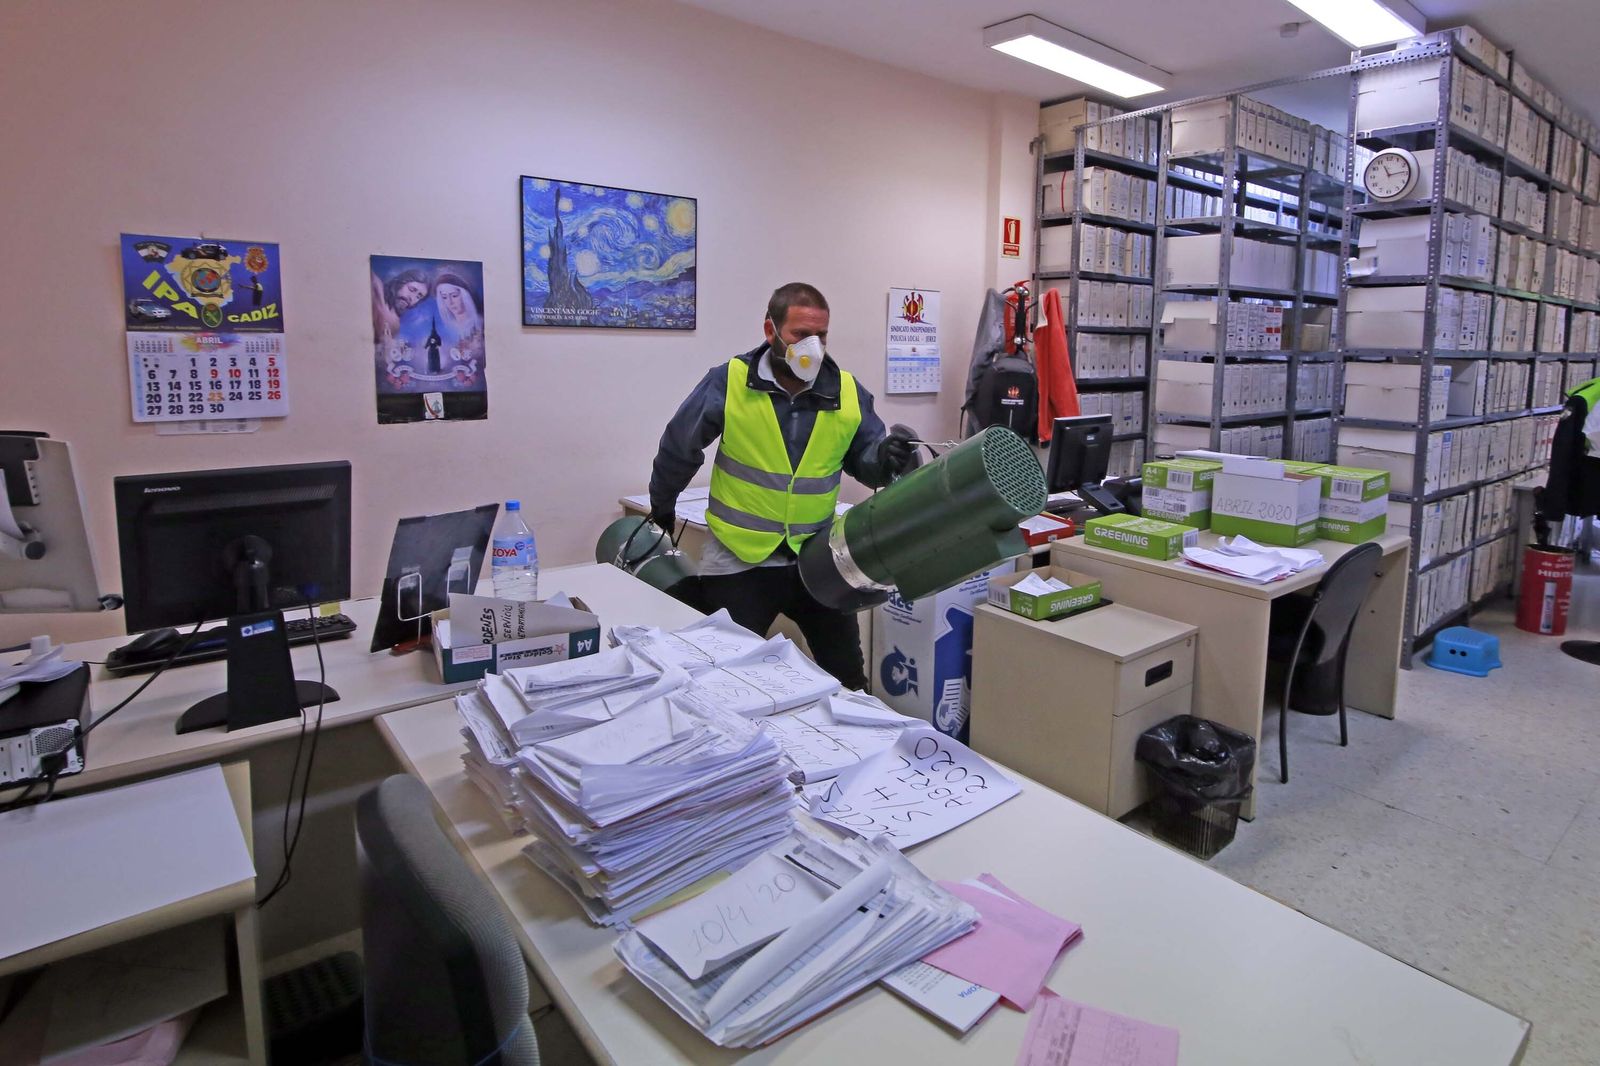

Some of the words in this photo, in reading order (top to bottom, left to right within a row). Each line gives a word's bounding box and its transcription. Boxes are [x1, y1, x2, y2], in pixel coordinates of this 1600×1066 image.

[142, 270, 198, 319] IPA
[227, 303, 278, 323] CADIZ
[196, 336, 224, 344] ABRIL
[190, 358, 196, 367] 1
[210, 358, 217, 366] 2
[230, 358, 237, 366] 3
[249, 358, 257, 366] 4
[268, 358, 275, 366] 5
[148, 371, 156, 380] 6
[169, 370, 177, 378] 7
[190, 370, 198, 378] 8
[211, 369, 218, 378] 9
[229, 369, 241, 378] 10
[248, 369, 259, 378] 11
[267, 368, 279, 377] 12
[147, 382, 160, 391] 13
[168, 382, 181, 391] 14
[189, 381, 202, 390] 15
[209, 381, 222, 390] 16
[229, 380, 241, 389] 17
[249, 380, 261, 389] 18
[268, 380, 280, 389] 19
[147, 394, 162, 403] 20
[168, 393, 181, 402] 21
[188, 393, 203, 402] 22
[208, 392, 223, 401] 23
[229, 392, 243, 401] 24
[248, 391, 262, 400] 25
[267, 391, 281, 400] 26
[147, 406, 162, 415] 27
[168, 405, 183, 414] 28
[189, 404, 204, 414] 29
[210, 404, 224, 413] 30
[1216, 496, 1253, 514] ABRIL
[1258, 502, 1292, 520] 2020
[1094, 527, 1148, 546] GREENING
[1050, 594, 1094, 612] GREENING
[524, 648, 554, 658] Golden
[577, 638, 592, 652] A4
[763, 654, 814, 685] 2020
[914, 736, 992, 794] 2020
[888, 755, 973, 808] ABRIL
